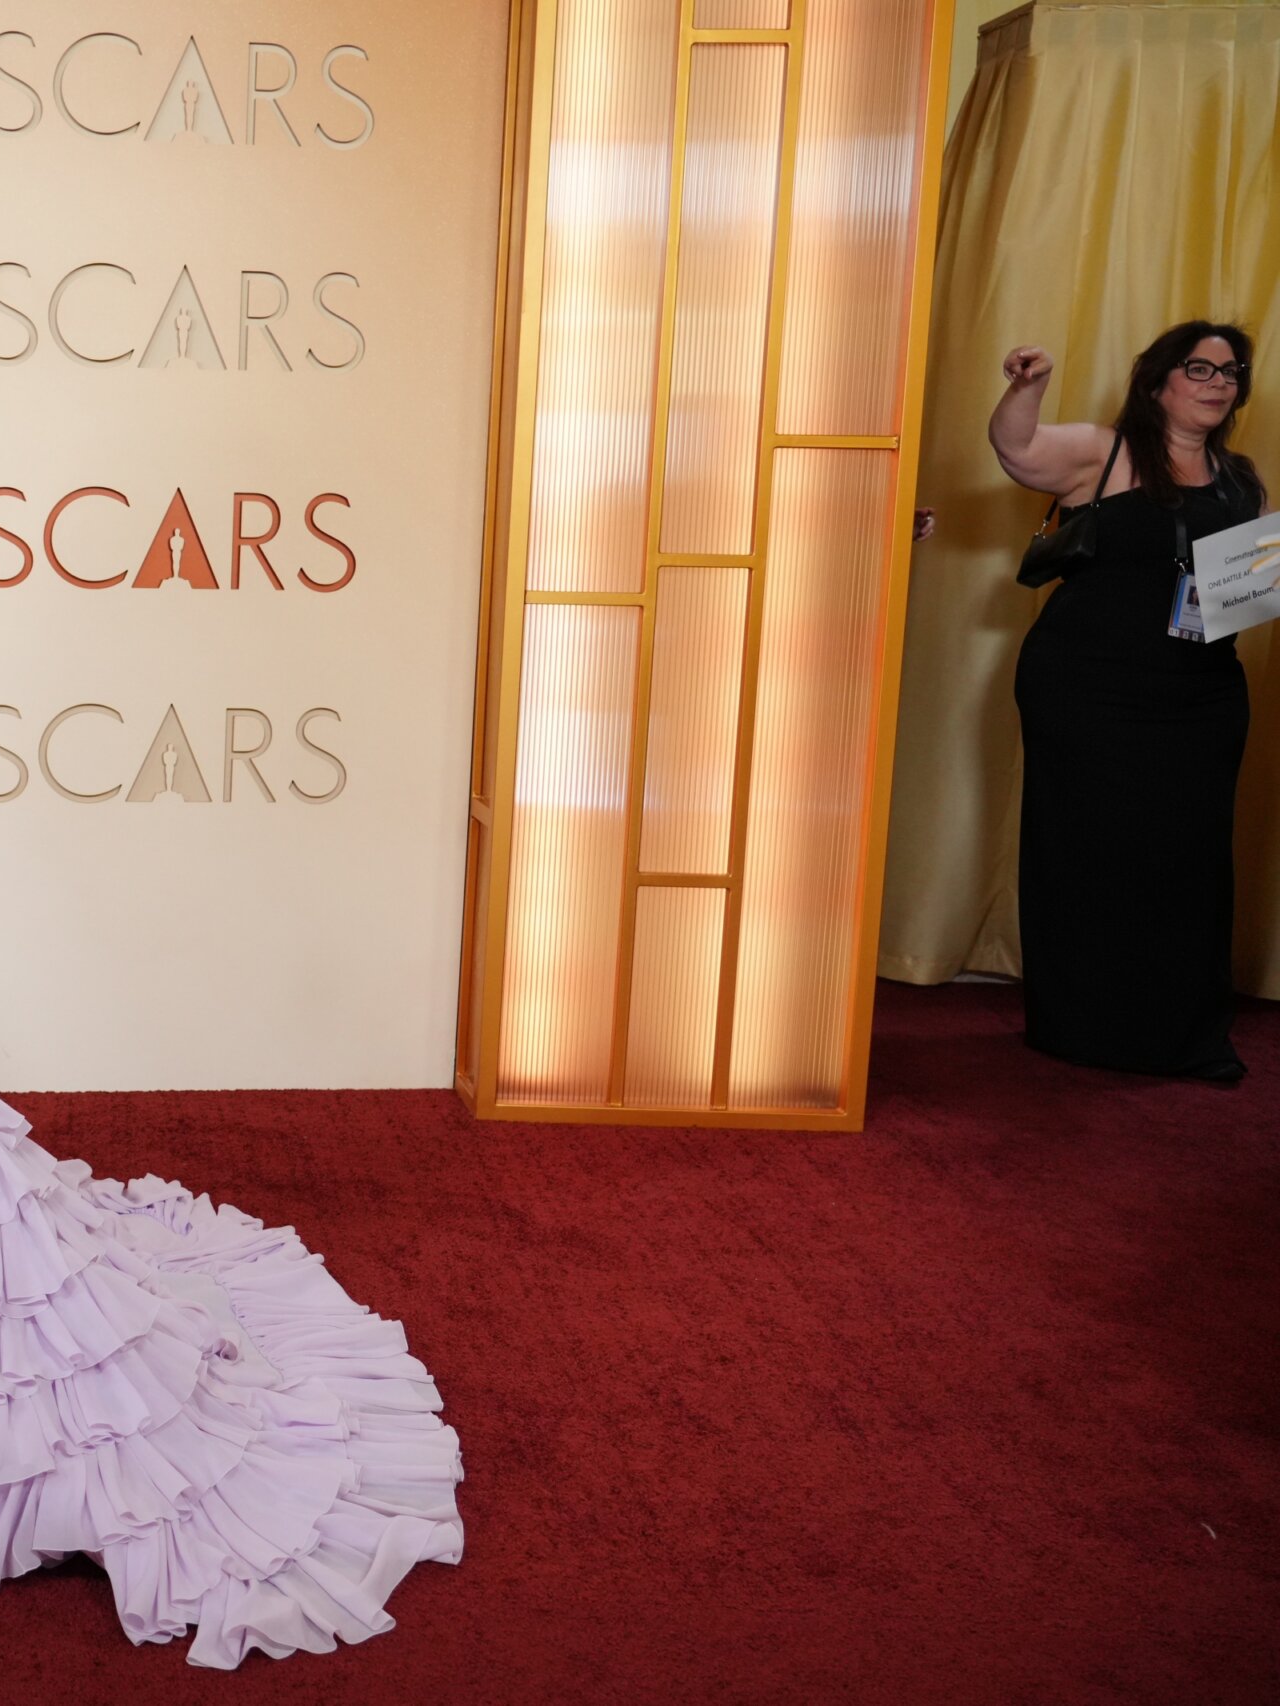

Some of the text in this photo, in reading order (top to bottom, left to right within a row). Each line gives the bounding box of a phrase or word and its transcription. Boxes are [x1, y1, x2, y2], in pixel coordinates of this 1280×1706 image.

[1208, 579, 1222, 590] ONE
[1223, 572, 1242, 585] BATTLE
[1222, 586, 1274, 610] Michael Baum
